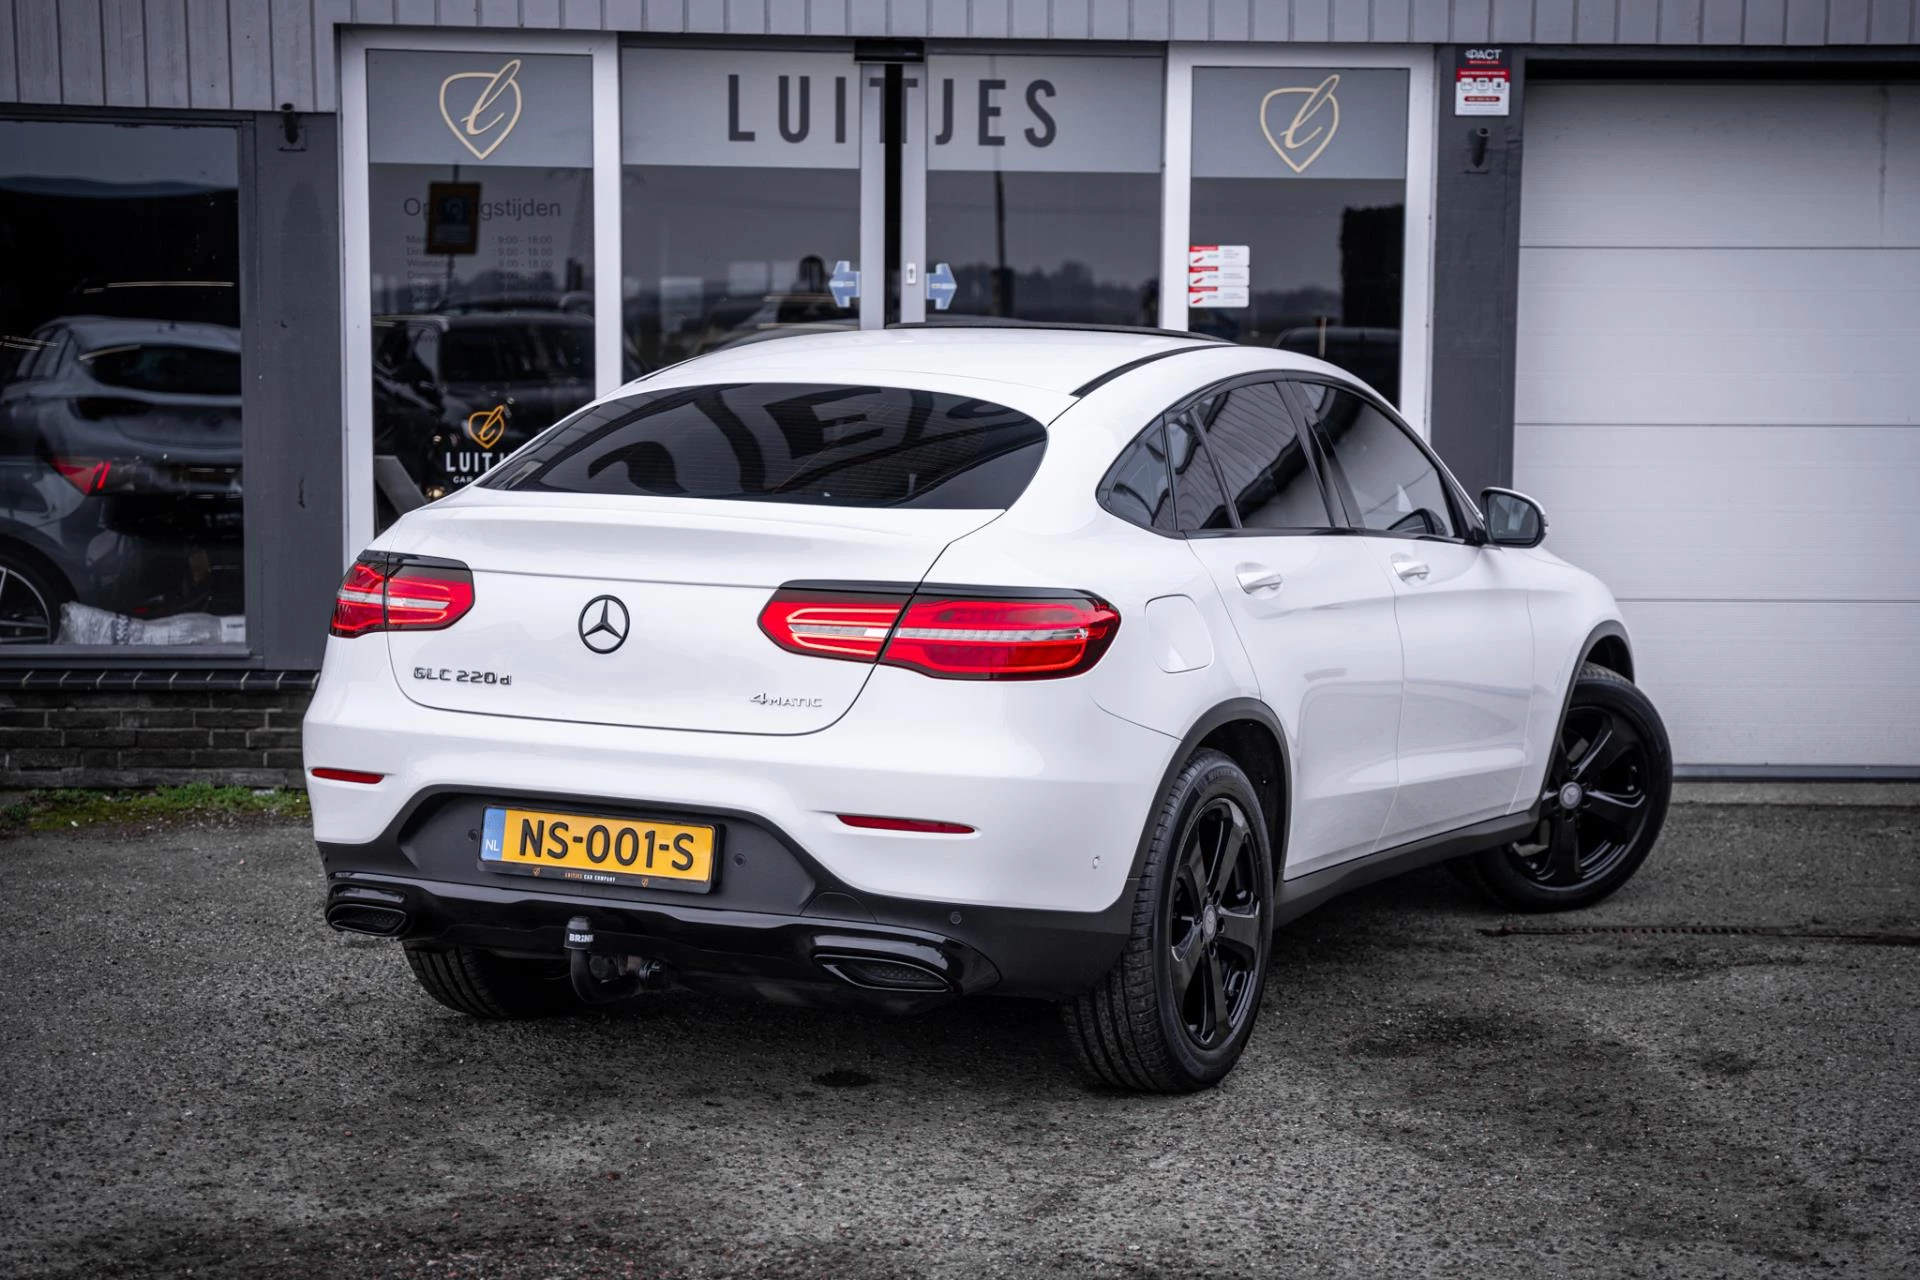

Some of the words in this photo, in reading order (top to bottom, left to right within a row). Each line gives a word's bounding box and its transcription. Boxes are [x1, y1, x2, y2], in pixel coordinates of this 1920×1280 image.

[728, 74, 1056, 148] LUITJES
[413, 666, 452, 681] GLC
[750, 692, 823, 708] 4MATIC
[485, 839, 500, 852] NL
[519, 818, 694, 871] NS-001-S
